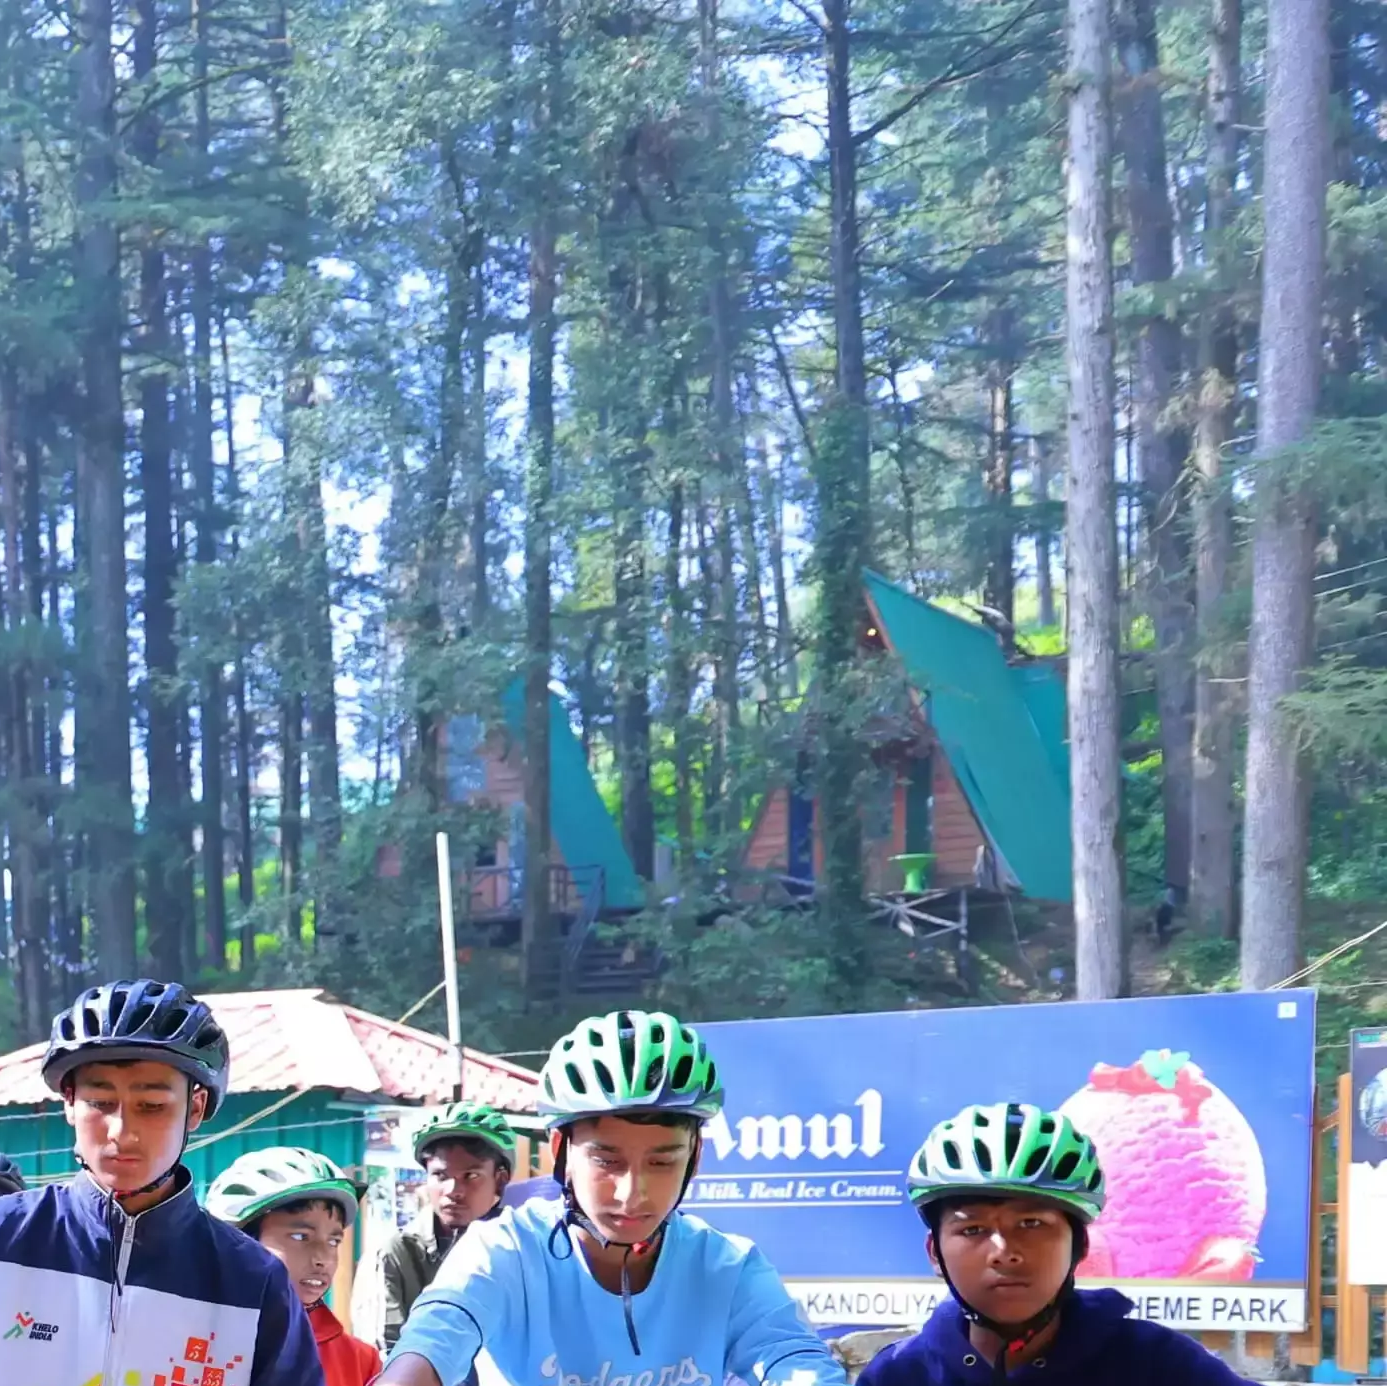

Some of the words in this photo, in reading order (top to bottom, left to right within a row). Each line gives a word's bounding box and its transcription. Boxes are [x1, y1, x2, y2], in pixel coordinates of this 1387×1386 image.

[749, 1180, 793, 1200] Real
[797, 1180, 826, 1199] Ice
[830, 1179, 904, 1198] Cream.
[1131, 1295, 1207, 1322] HEME
[1212, 1296, 1288, 1323] PARK
[28, 1330, 53, 1342] INDIA
[31, 1322, 59, 1334] KHELO
